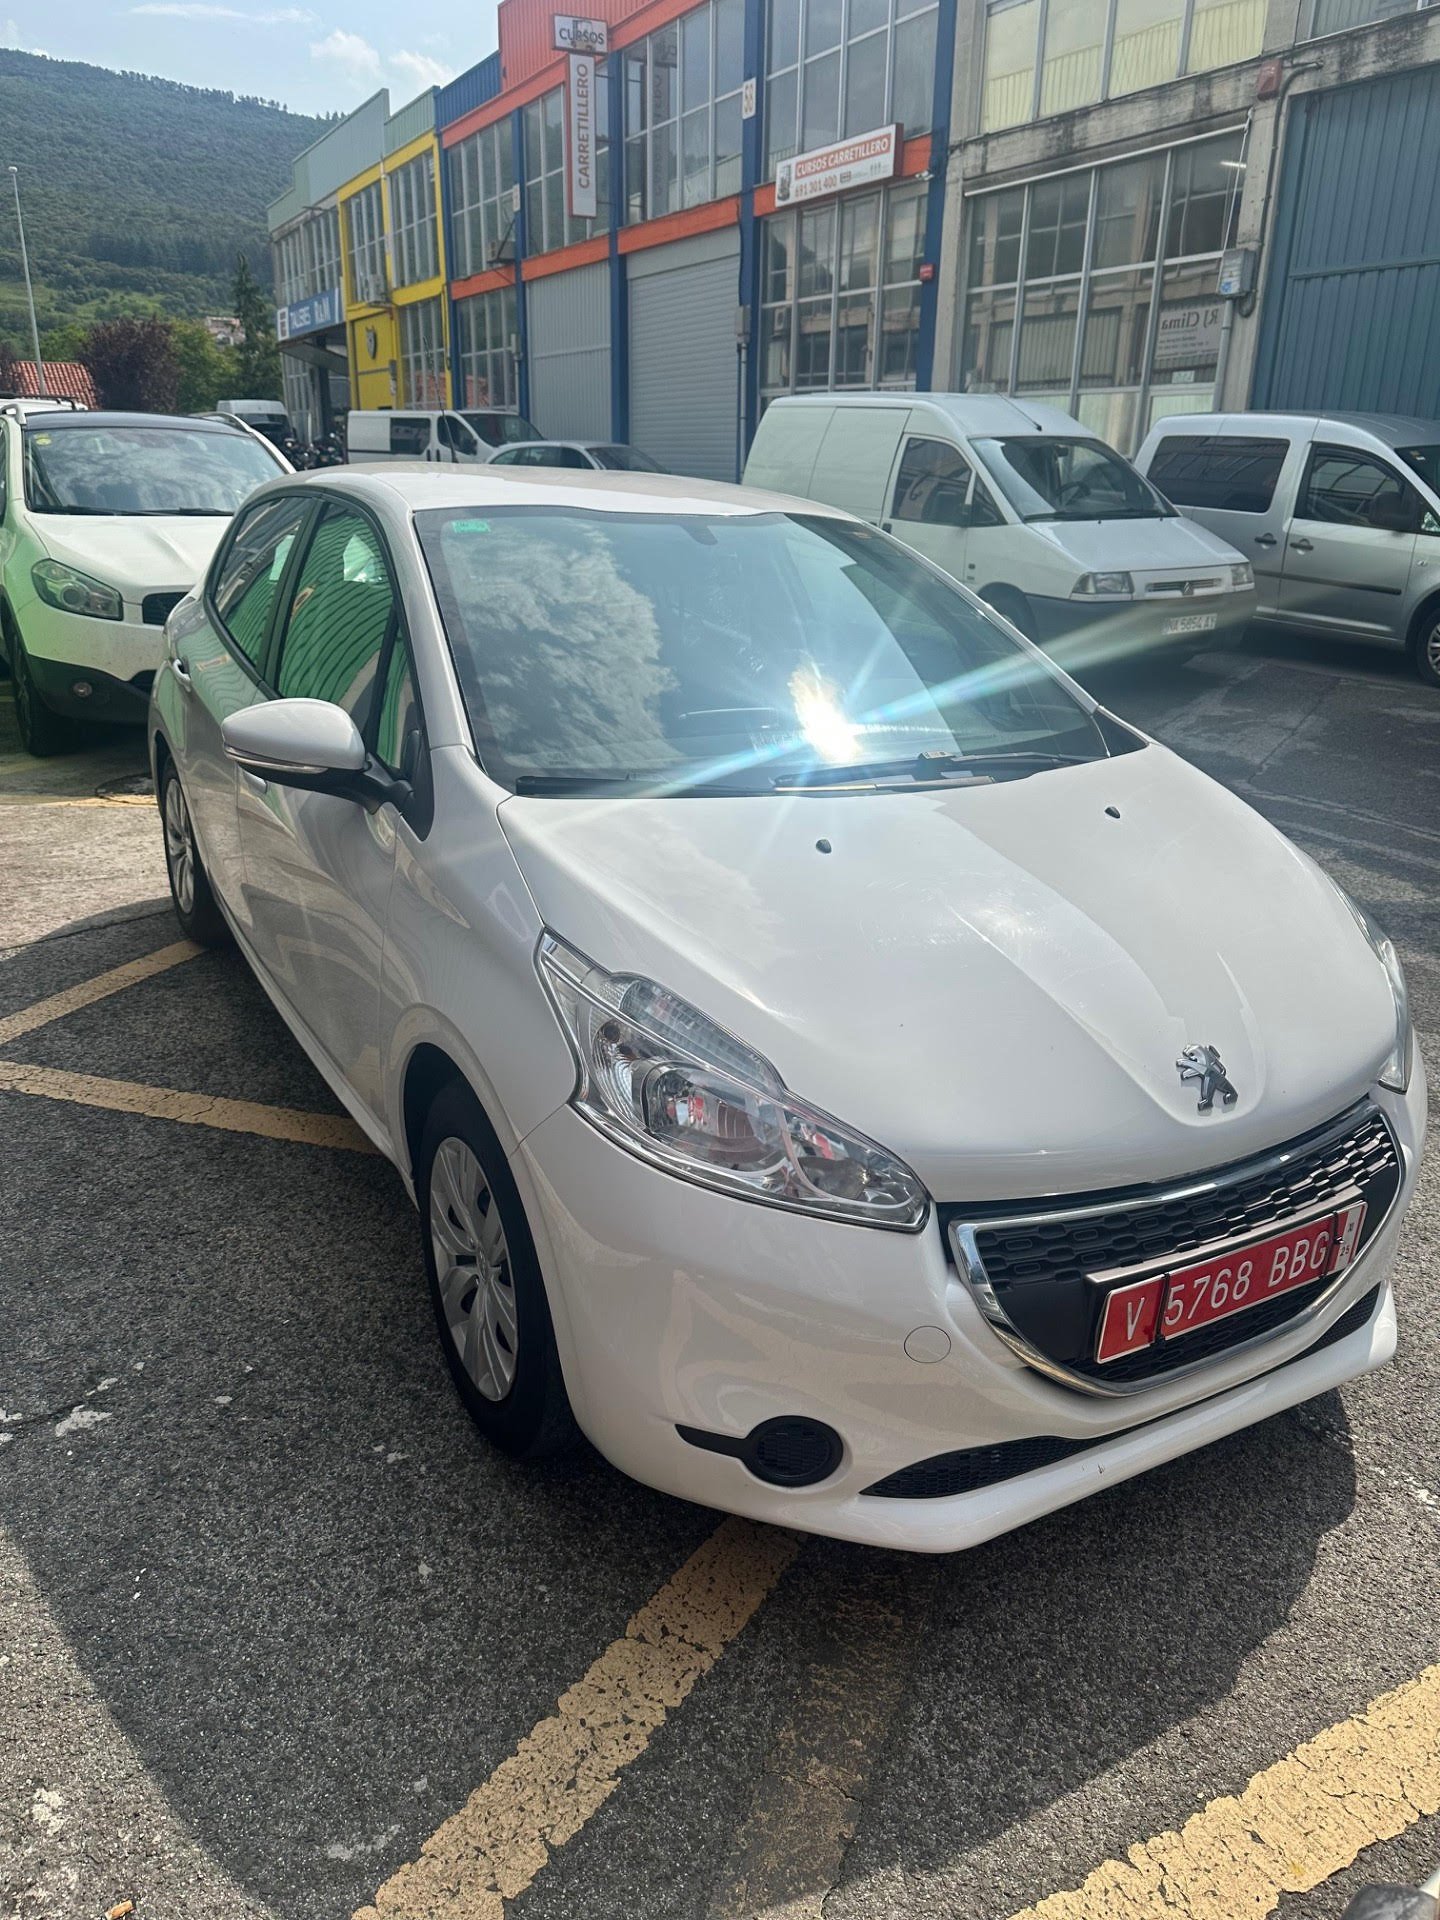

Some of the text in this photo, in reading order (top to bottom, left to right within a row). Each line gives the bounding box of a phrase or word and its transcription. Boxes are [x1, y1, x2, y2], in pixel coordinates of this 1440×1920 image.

[559, 28, 604, 45] CURSOS
[577, 64, 590, 189] CARRETILLERO
[796, 157, 827, 177] CURSOS
[828, 138, 889, 170] CARRETILLERO
[1127, 1231, 1330, 1341] V 5768 BBG
